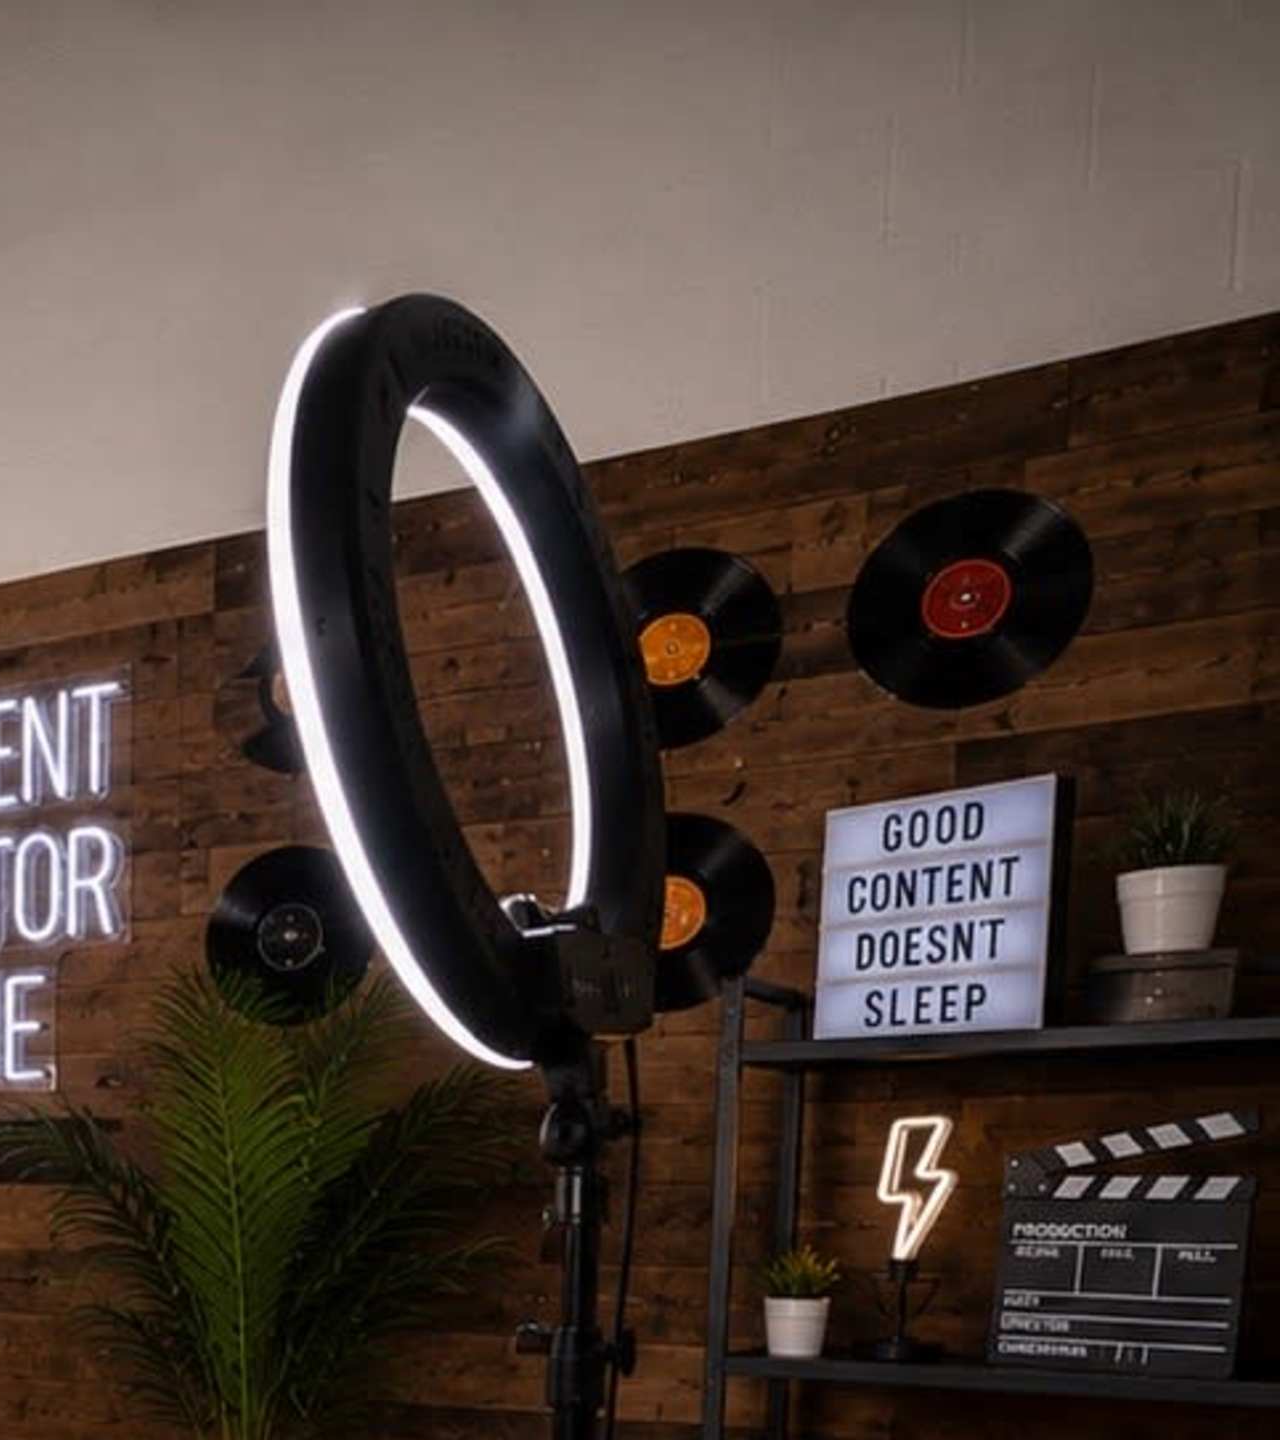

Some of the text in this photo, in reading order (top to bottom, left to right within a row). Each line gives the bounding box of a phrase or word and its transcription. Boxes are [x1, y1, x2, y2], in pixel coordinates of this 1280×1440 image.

[882, 801, 986, 853] GOOD
[846, 856, 1021, 915] CONTENT
[864, 982, 987, 1029] SLEEP
[1012, 1222, 1128, 1240] PRODUCTION
